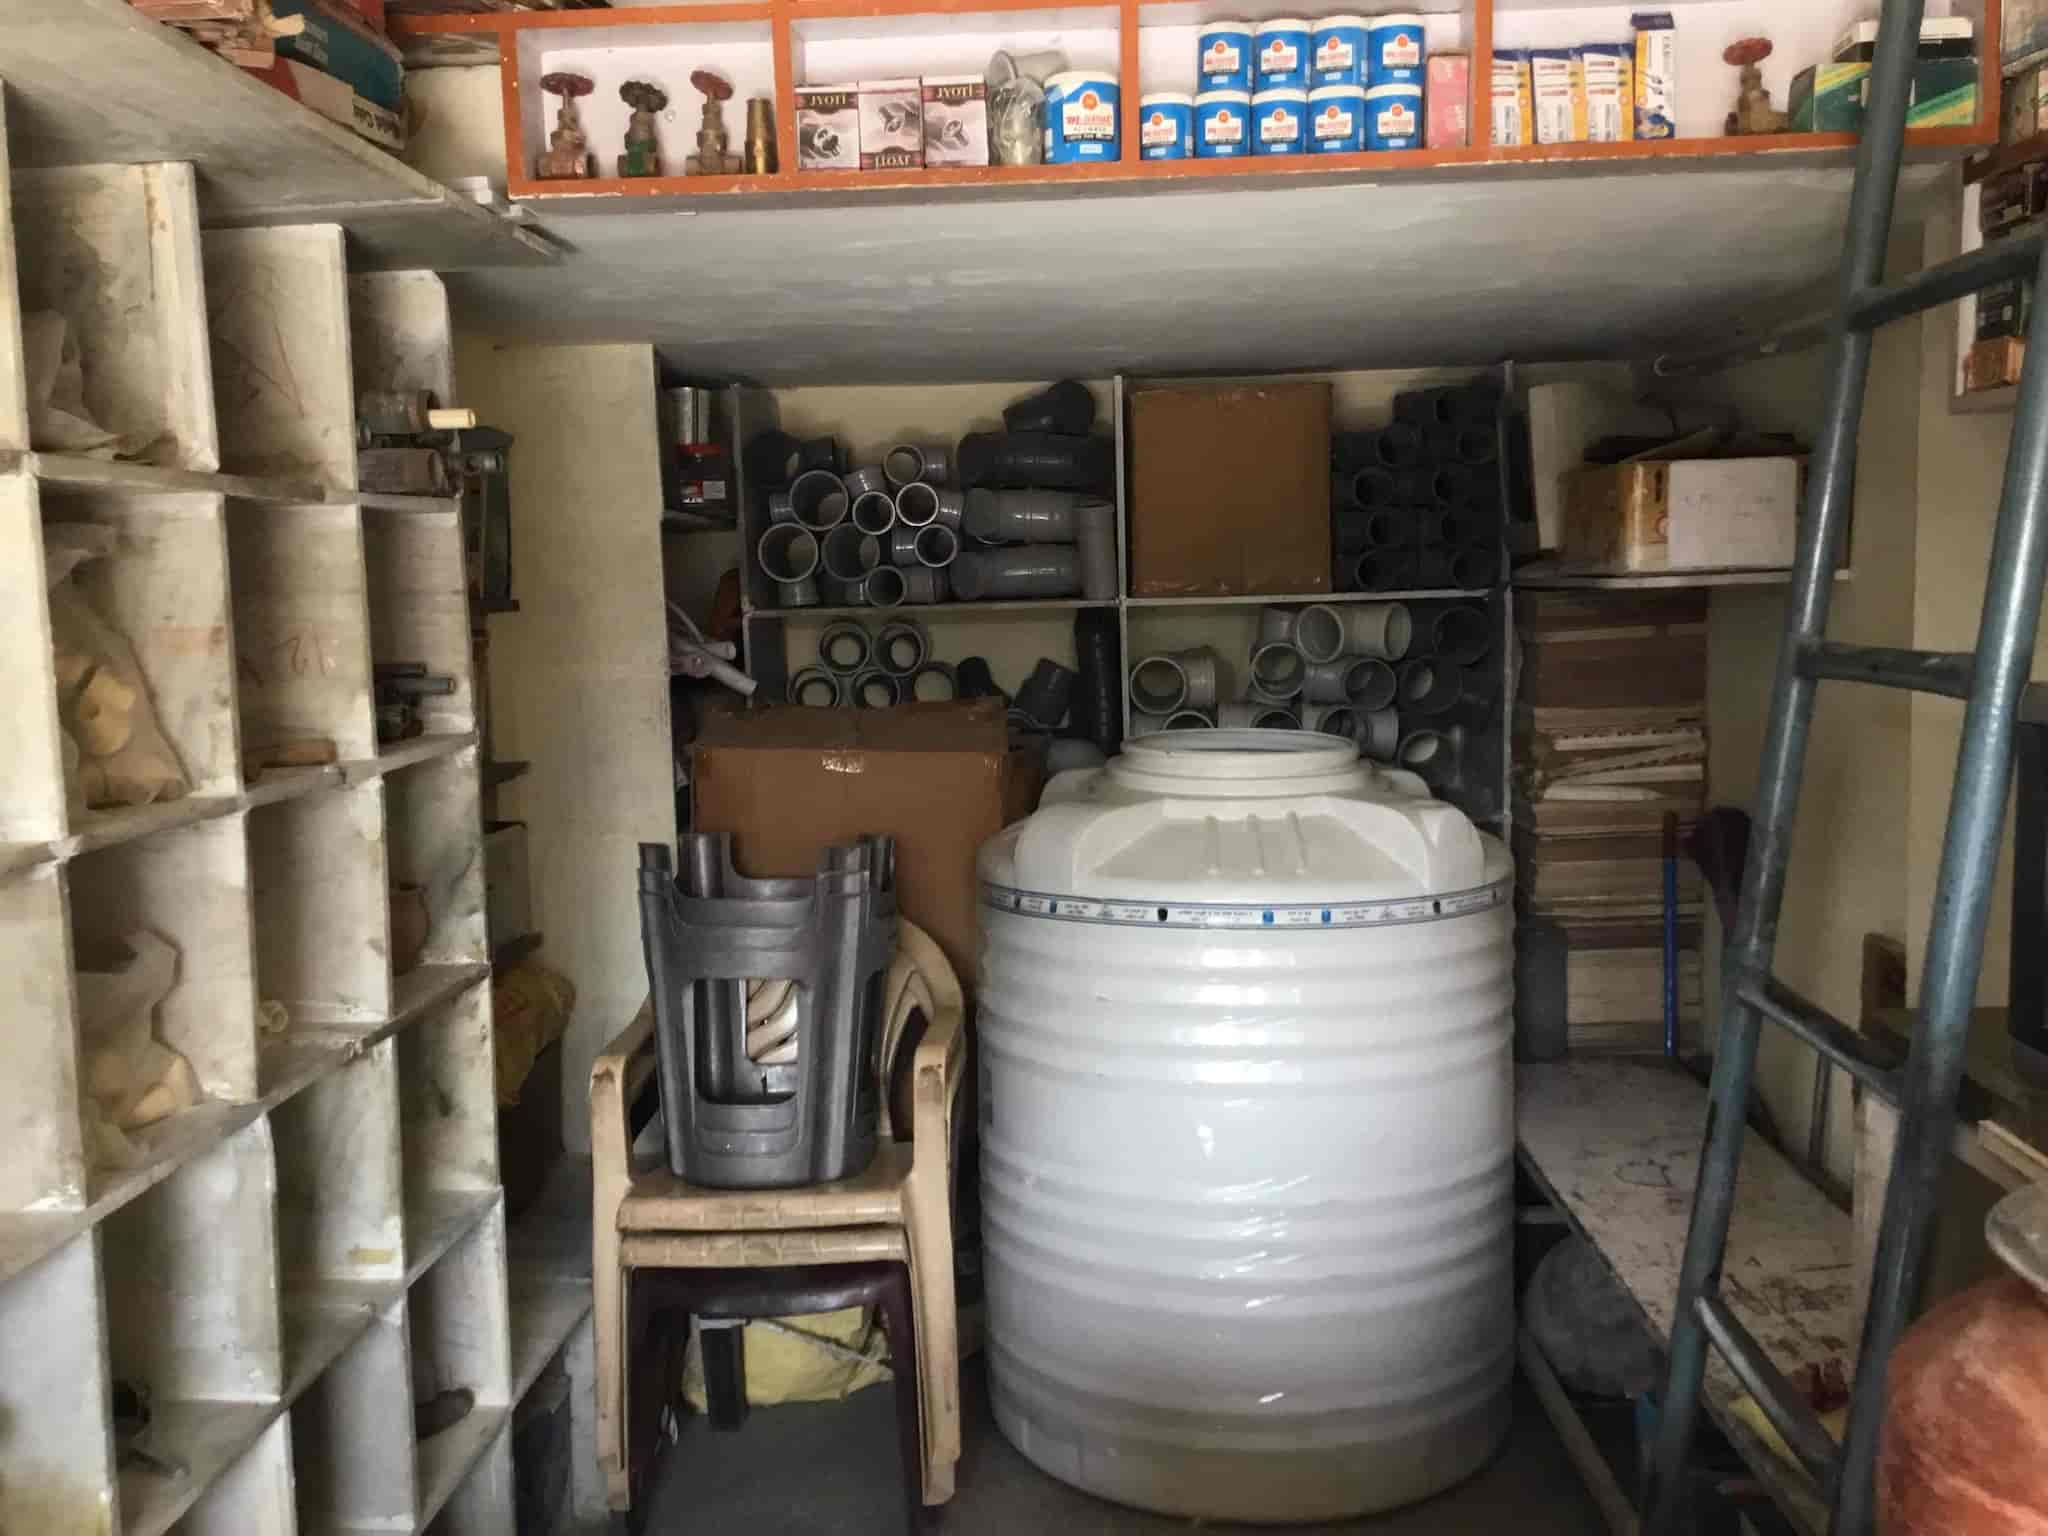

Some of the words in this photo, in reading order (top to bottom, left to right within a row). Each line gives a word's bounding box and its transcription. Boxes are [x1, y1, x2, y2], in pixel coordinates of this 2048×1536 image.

[936, 86, 973, 98] JYOTI
[810, 94, 846, 105] JYOTI
[875, 155, 911, 168] JYOTI
